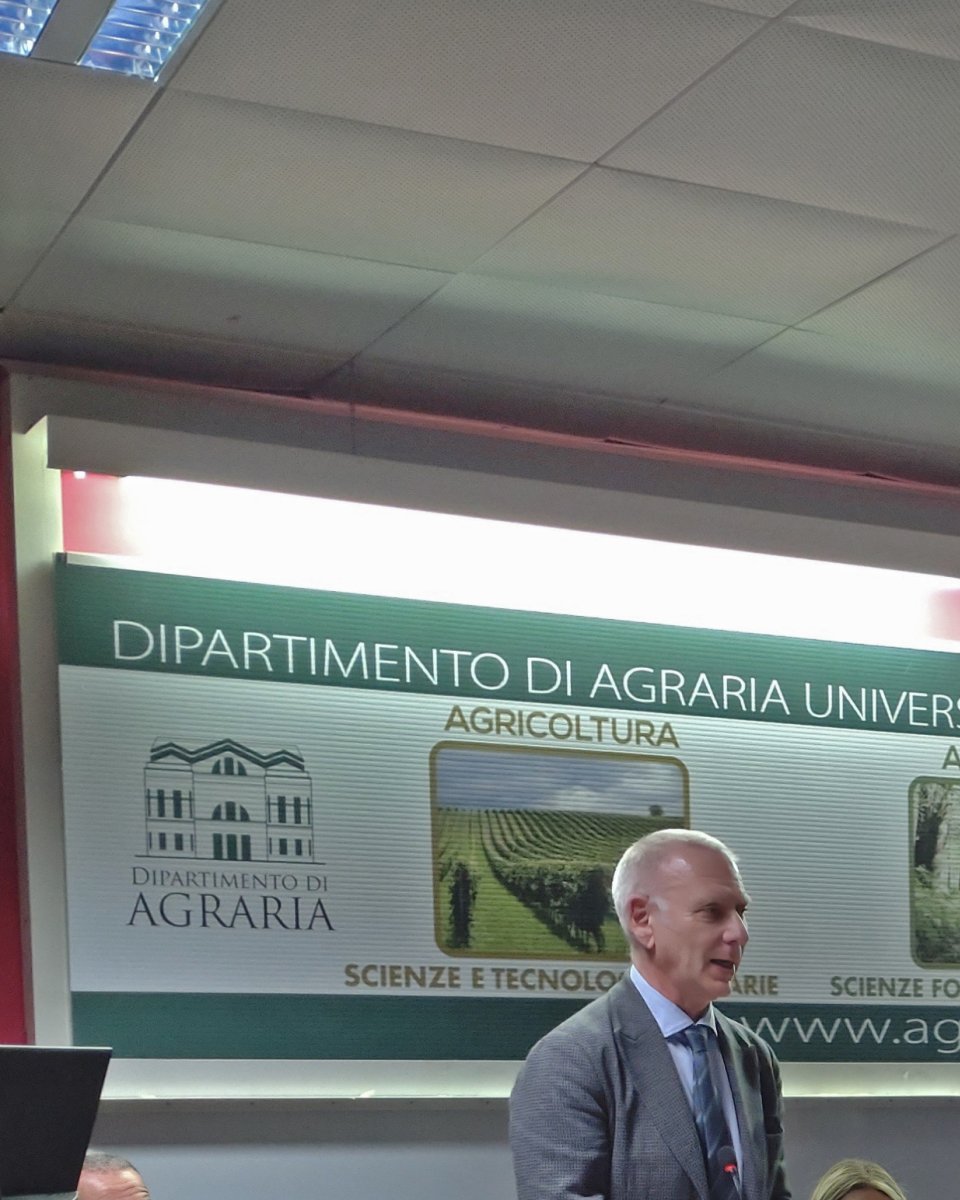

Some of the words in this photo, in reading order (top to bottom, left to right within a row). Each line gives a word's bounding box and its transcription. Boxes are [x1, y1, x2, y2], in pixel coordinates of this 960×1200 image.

[113, 619, 510, 691] DIPARTIMENTO
[527, 656, 572, 696] DI
[590, 663, 791, 715] AGRARIA
[444, 705, 680, 749] AGRICOLTURA
[126, 891, 335, 931] AGRARIA
[344, 963, 461, 989] SCIENZE
[472, 966, 484, 989] E
[491, 967, 626, 992] TECNOLO
[830, 975, 923, 997] SCIENZE
